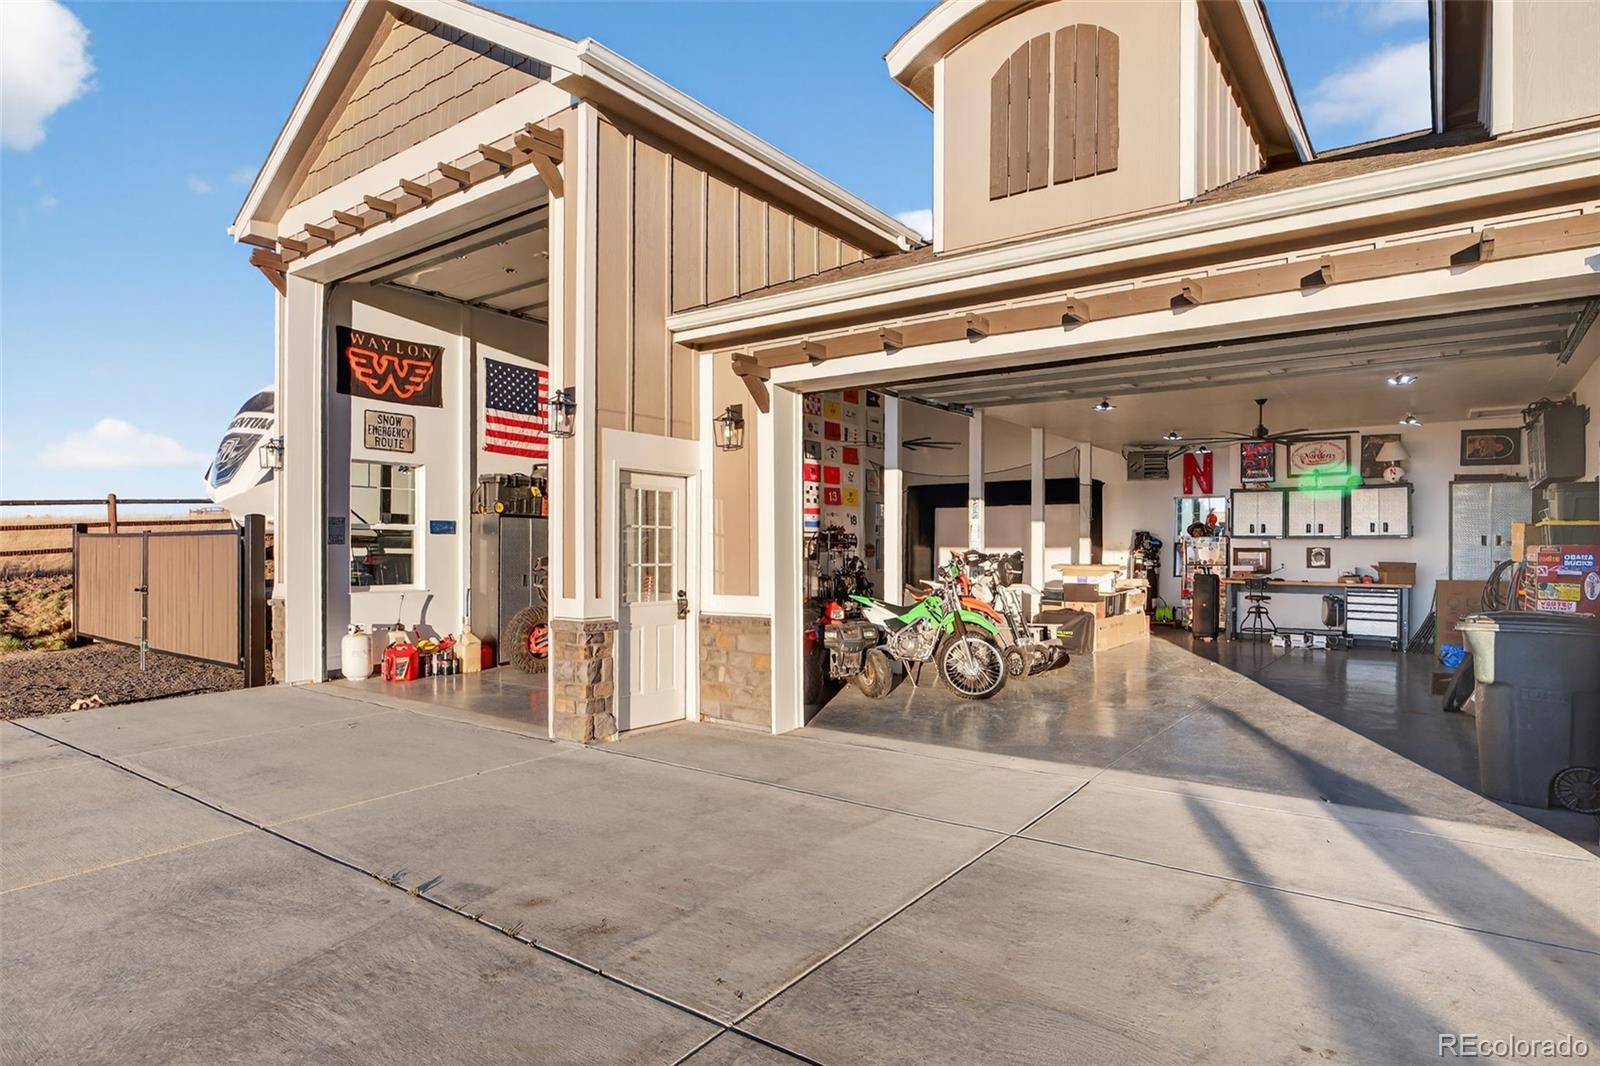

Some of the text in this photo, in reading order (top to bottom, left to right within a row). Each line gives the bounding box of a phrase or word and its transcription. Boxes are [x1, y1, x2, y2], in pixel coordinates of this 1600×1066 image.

[350, 332, 433, 359] WAYLON
[377, 414, 403, 427] SNOW
[367, 424, 412, 439] EMERGENCY
[374, 436, 405, 449] ROUTE
[1183, 452, 1213, 494] N
[829, 491, 838, 502] 13
